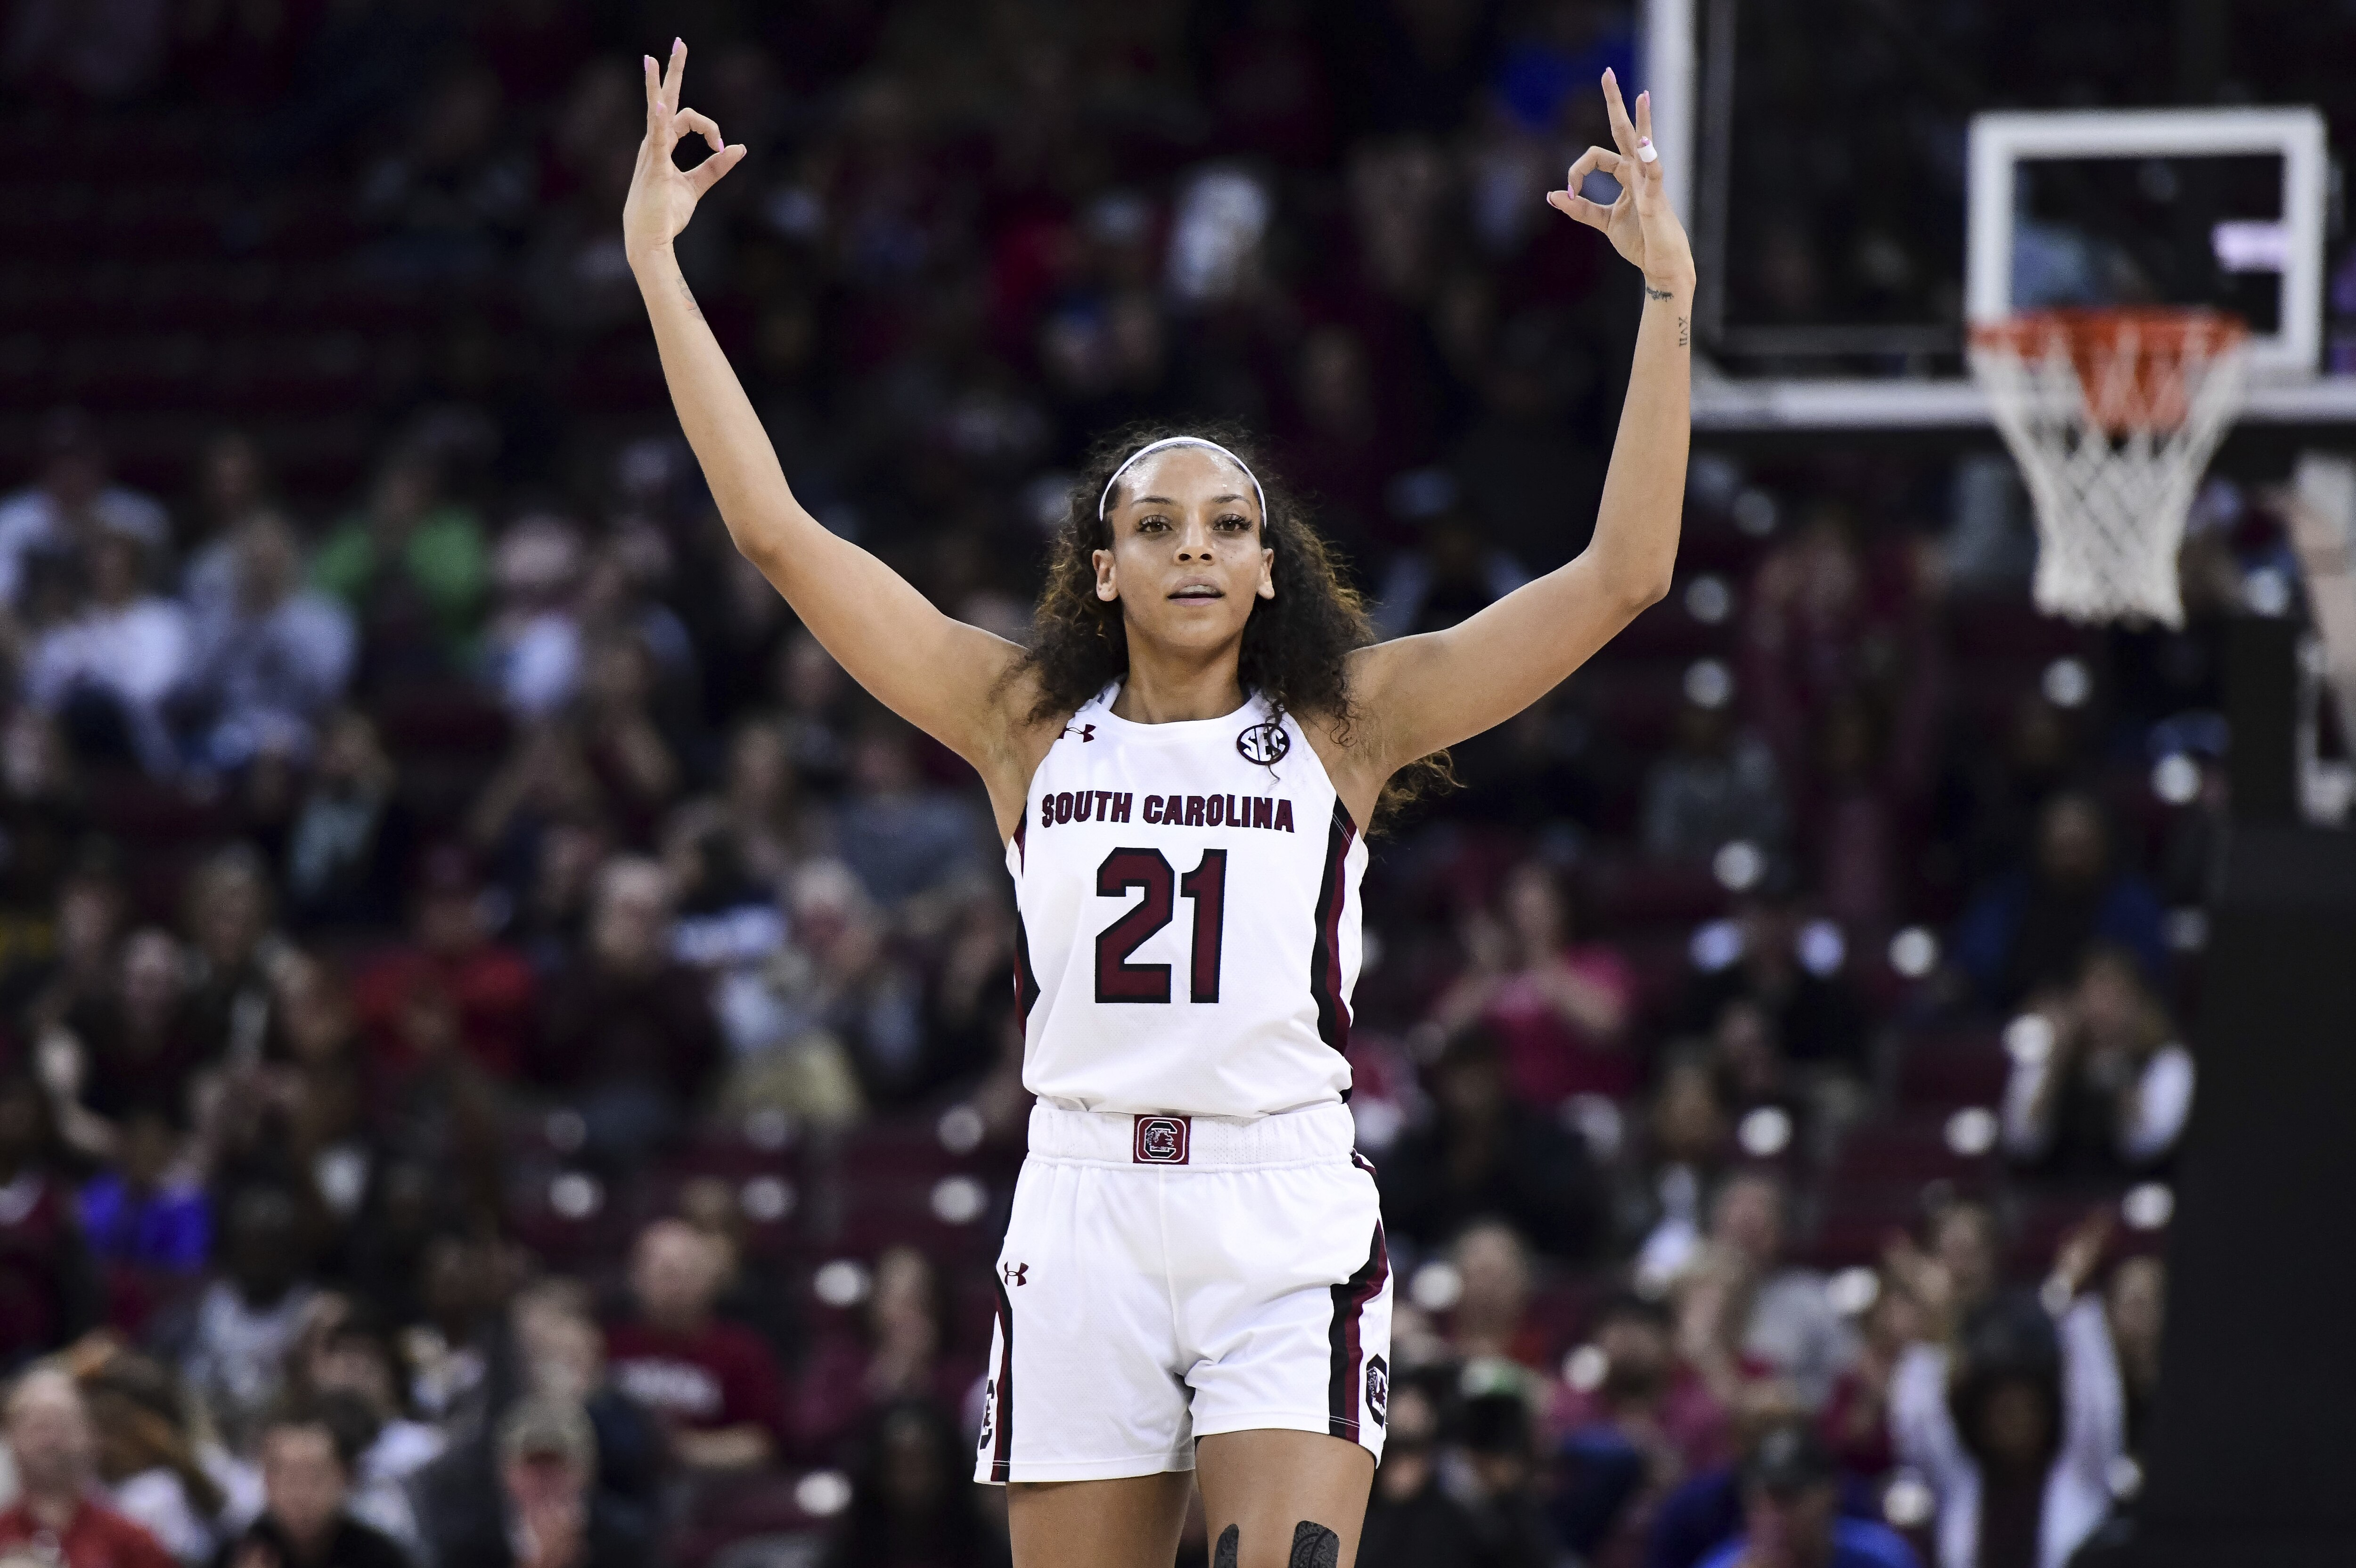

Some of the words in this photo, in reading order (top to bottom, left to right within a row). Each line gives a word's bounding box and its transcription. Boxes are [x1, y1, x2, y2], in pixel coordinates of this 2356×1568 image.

[1240, 726, 1286, 762] SEC
[1041, 790, 1133, 828] SOUTH
[1142, 793, 1295, 833] CAROLINA
[1095, 847, 1227, 1004] 21
